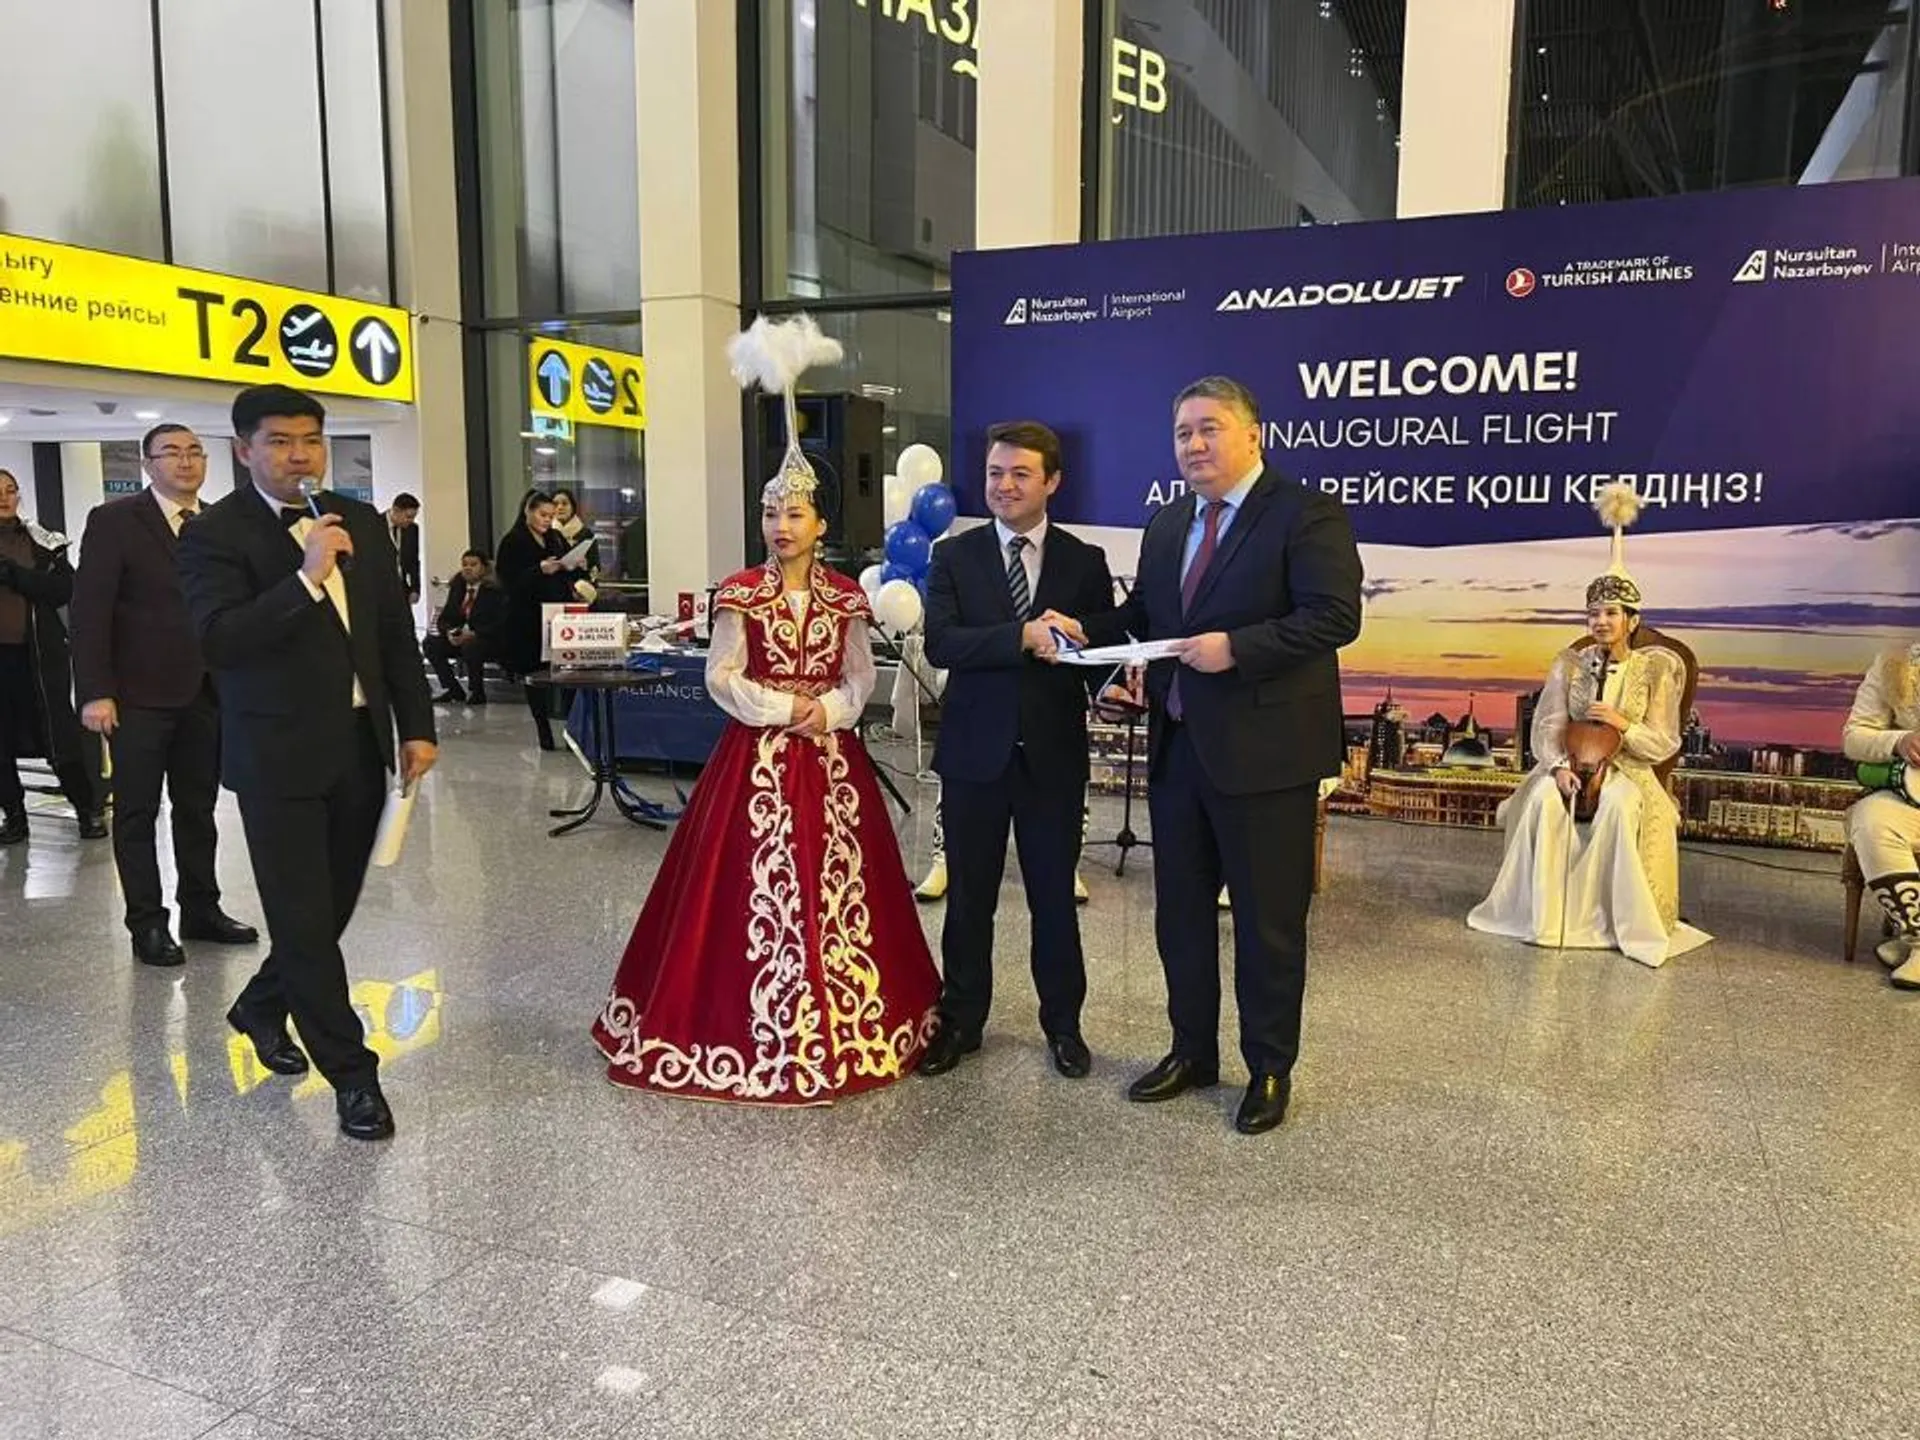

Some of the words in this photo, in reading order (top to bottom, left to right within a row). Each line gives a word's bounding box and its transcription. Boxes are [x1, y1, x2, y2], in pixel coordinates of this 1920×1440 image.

[1564, 262, 1574, 271] A
[1577, 257, 1649, 270] TRADEMARK
[1652, 256, 1670, 266] OF
[1773, 246, 1858, 262] Nursultan
[1542, 271, 1613, 287] TURKISH
[1616, 266, 1693, 283] AIRLINES
[1773, 262, 1873, 279] Nazarbayev
[1031, 296, 1087, 310] Nursultan
[1111, 288, 1186, 304] International
[1216, 276, 1464, 311] ANADOLUJET
[88, 299, 166, 326] рейсы
[1031, 310, 1099, 323] Nazarbayev
[1111, 306, 1153, 320] Airport
[177, 287, 271, 368] T2
[1298, 351, 1578, 399] WELCOME!
[1261, 416, 1469, 449] INAUGURAL
[1482, 411, 1618, 444] FLIGHT
[1467, 473, 1550, 508] ҚОШ
